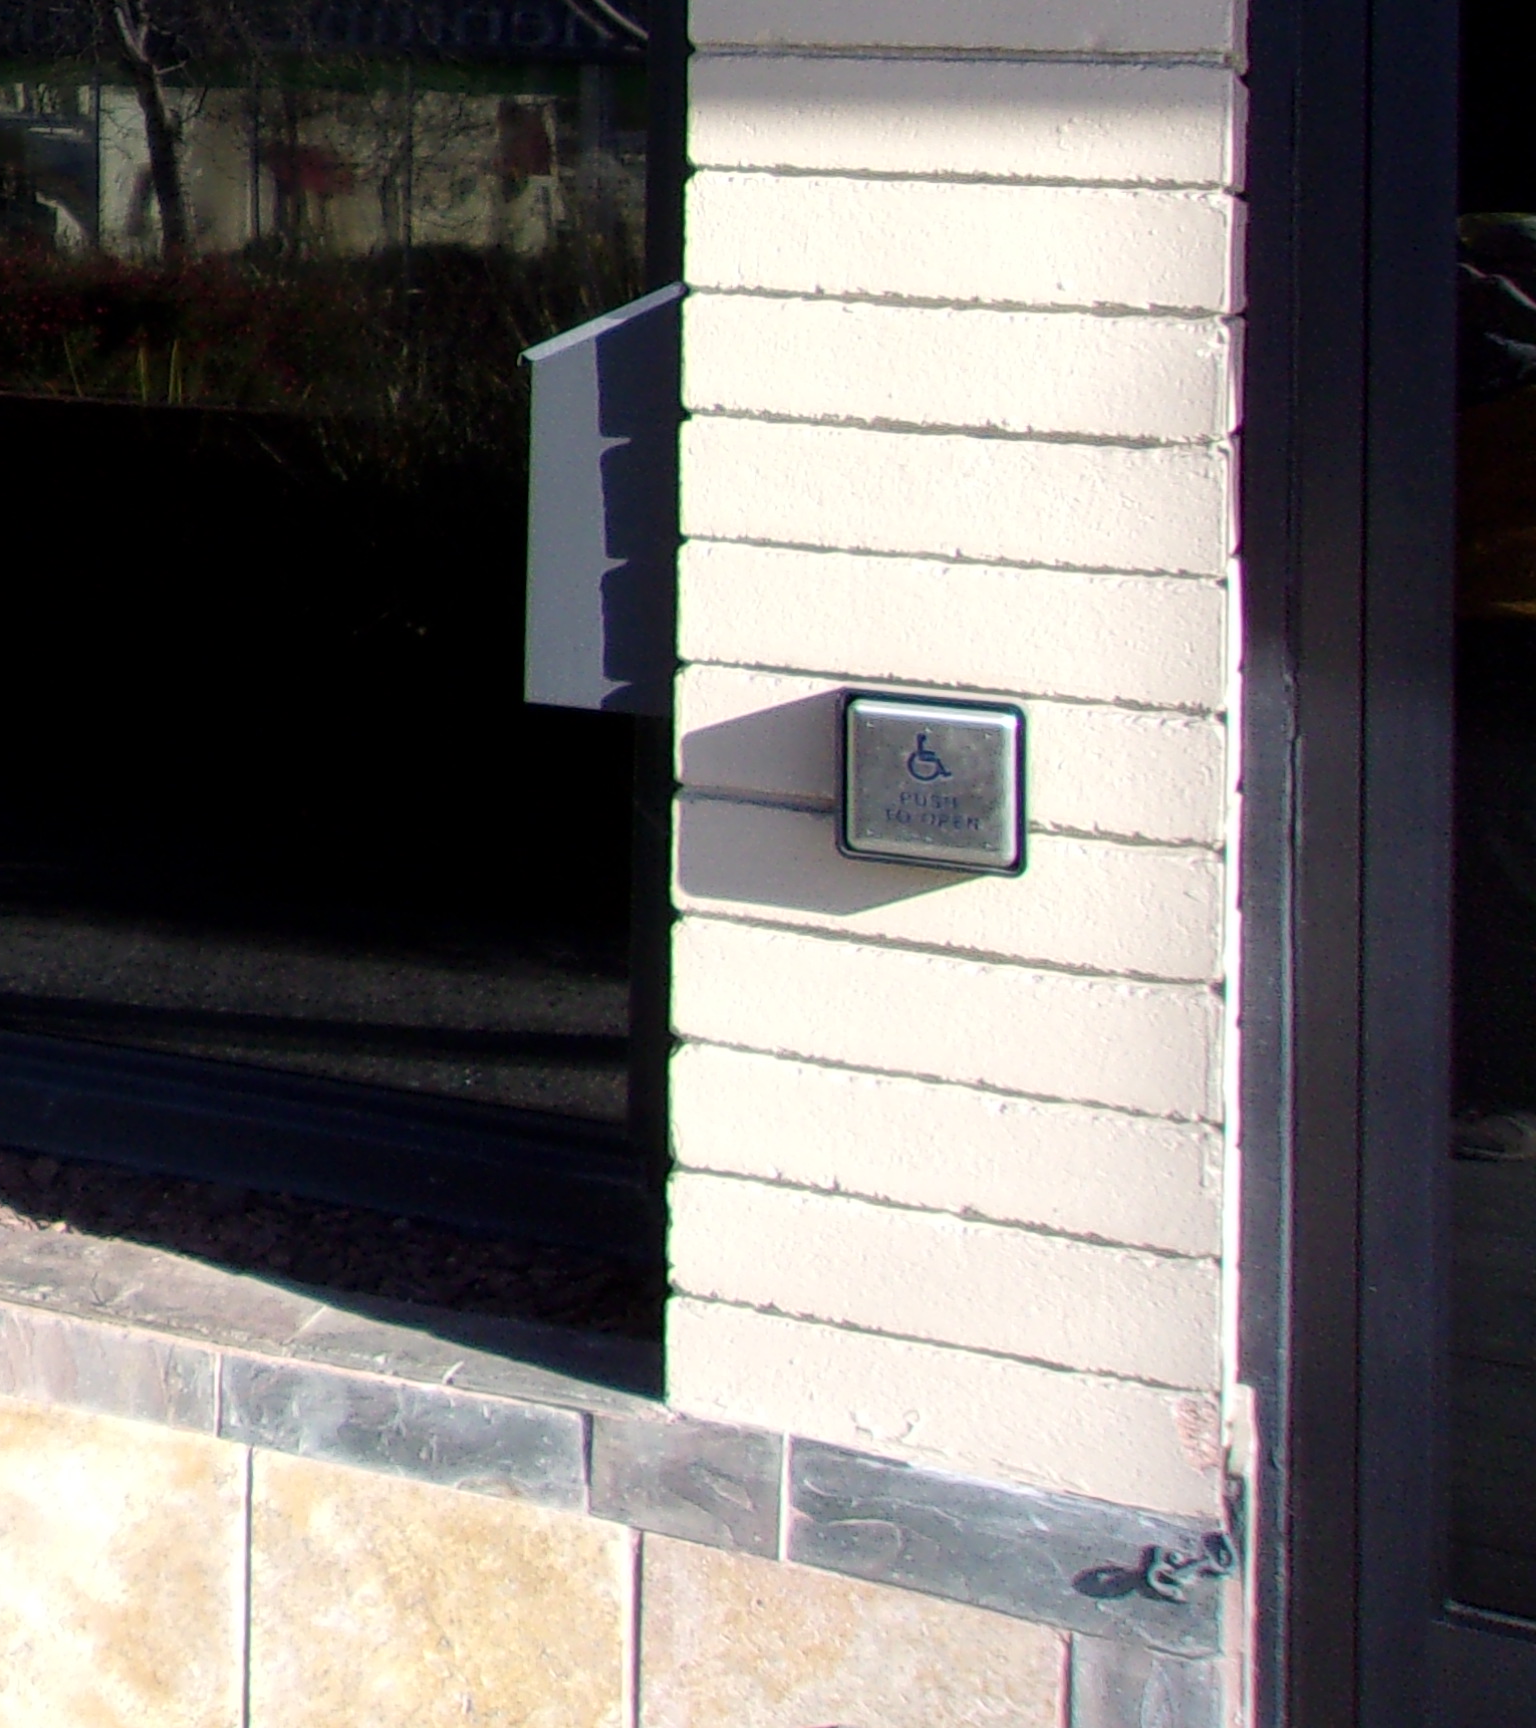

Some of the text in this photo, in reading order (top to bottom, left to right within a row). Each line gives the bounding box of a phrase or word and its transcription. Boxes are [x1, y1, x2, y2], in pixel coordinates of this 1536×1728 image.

[899, 791, 958, 809] PUSH
[885, 808, 980, 831] TO OPEN
